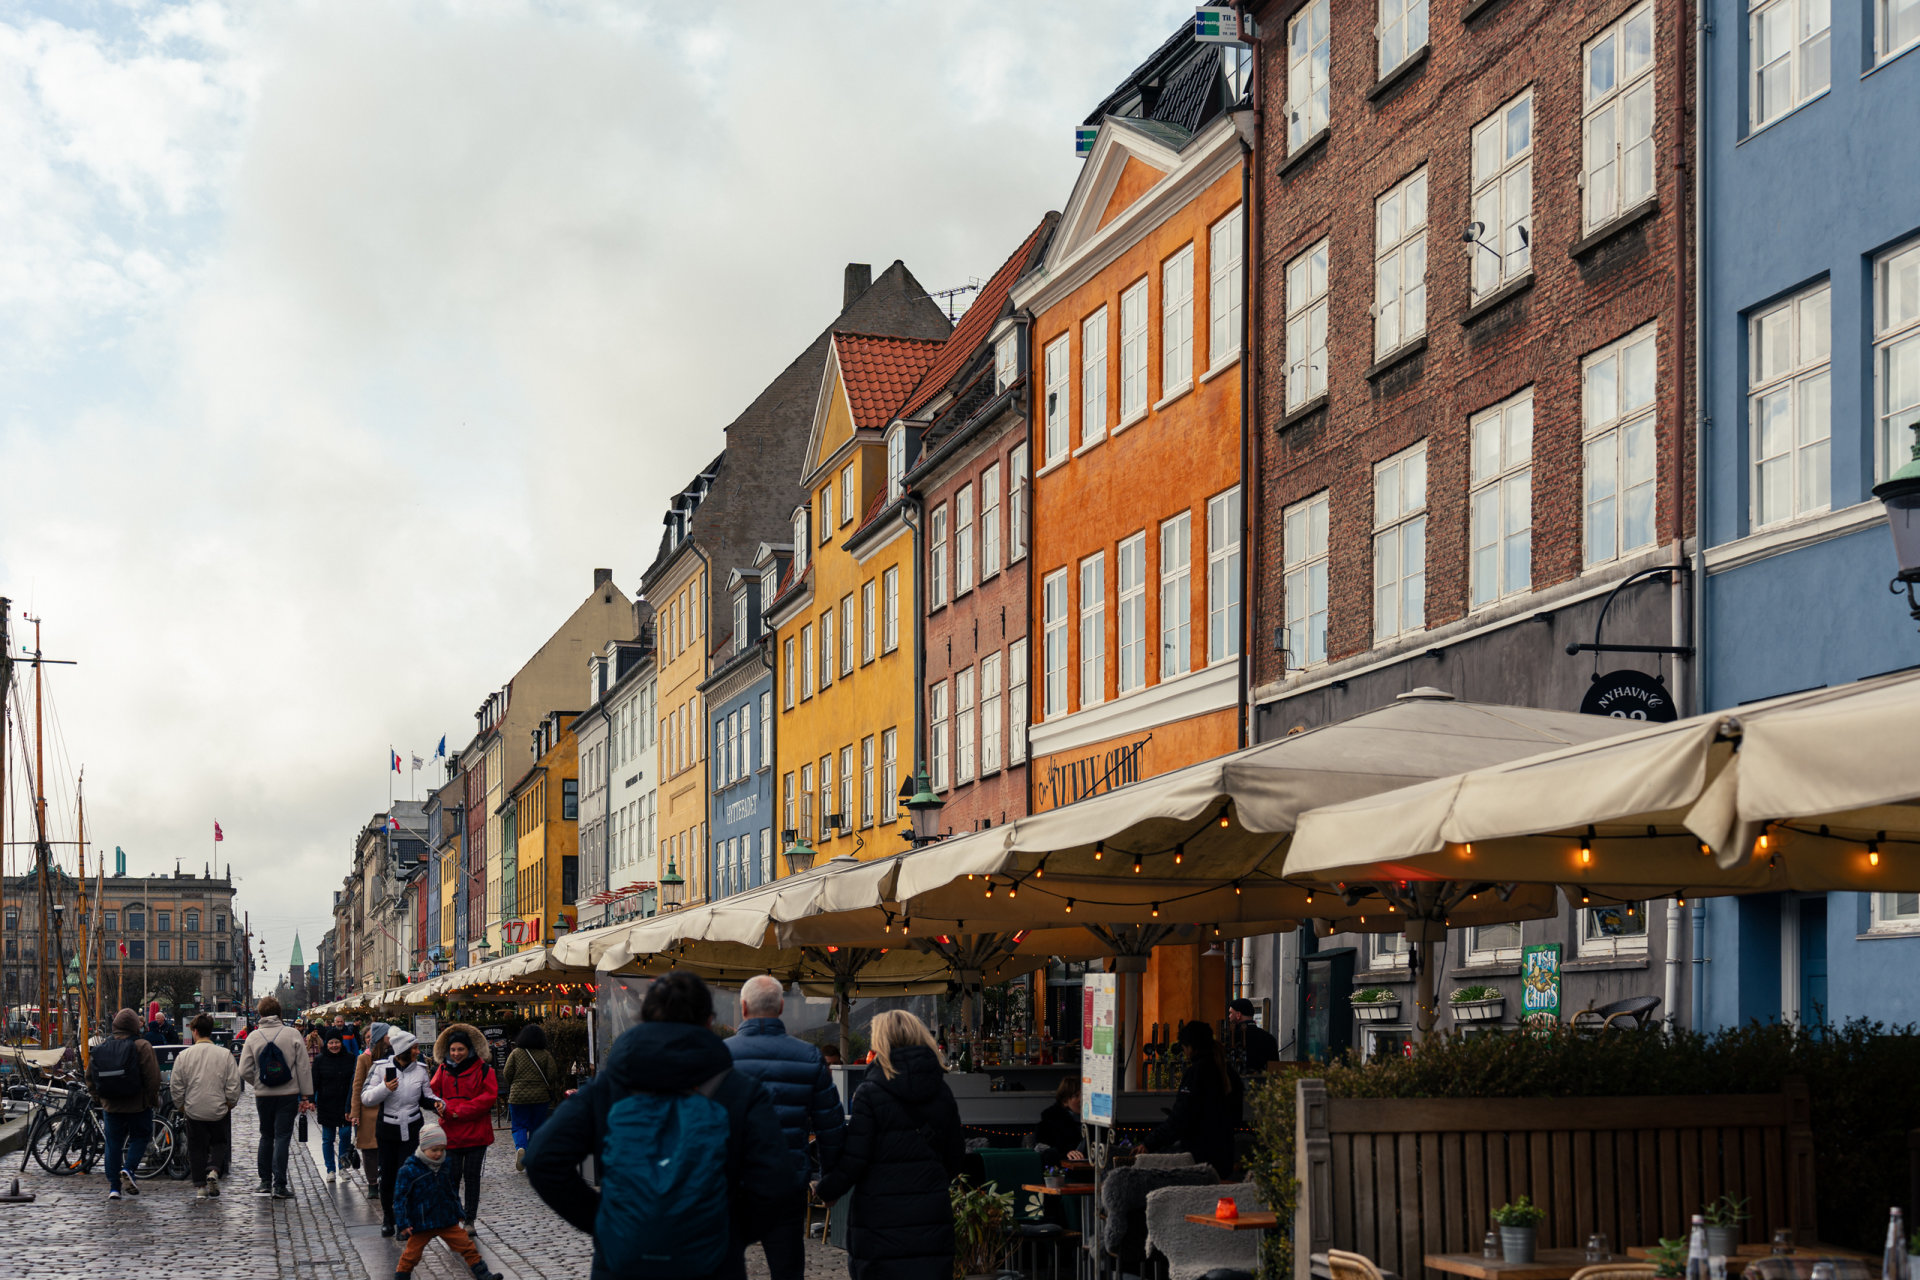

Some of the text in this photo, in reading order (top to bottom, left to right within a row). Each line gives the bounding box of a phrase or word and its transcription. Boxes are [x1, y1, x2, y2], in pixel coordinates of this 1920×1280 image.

[1598, 686, 1649, 709] NYHAVN
[502, 921, 526, 944] 17
[1527, 950, 1557, 976] FISH
[1524, 983, 1558, 1008] CHIPS
